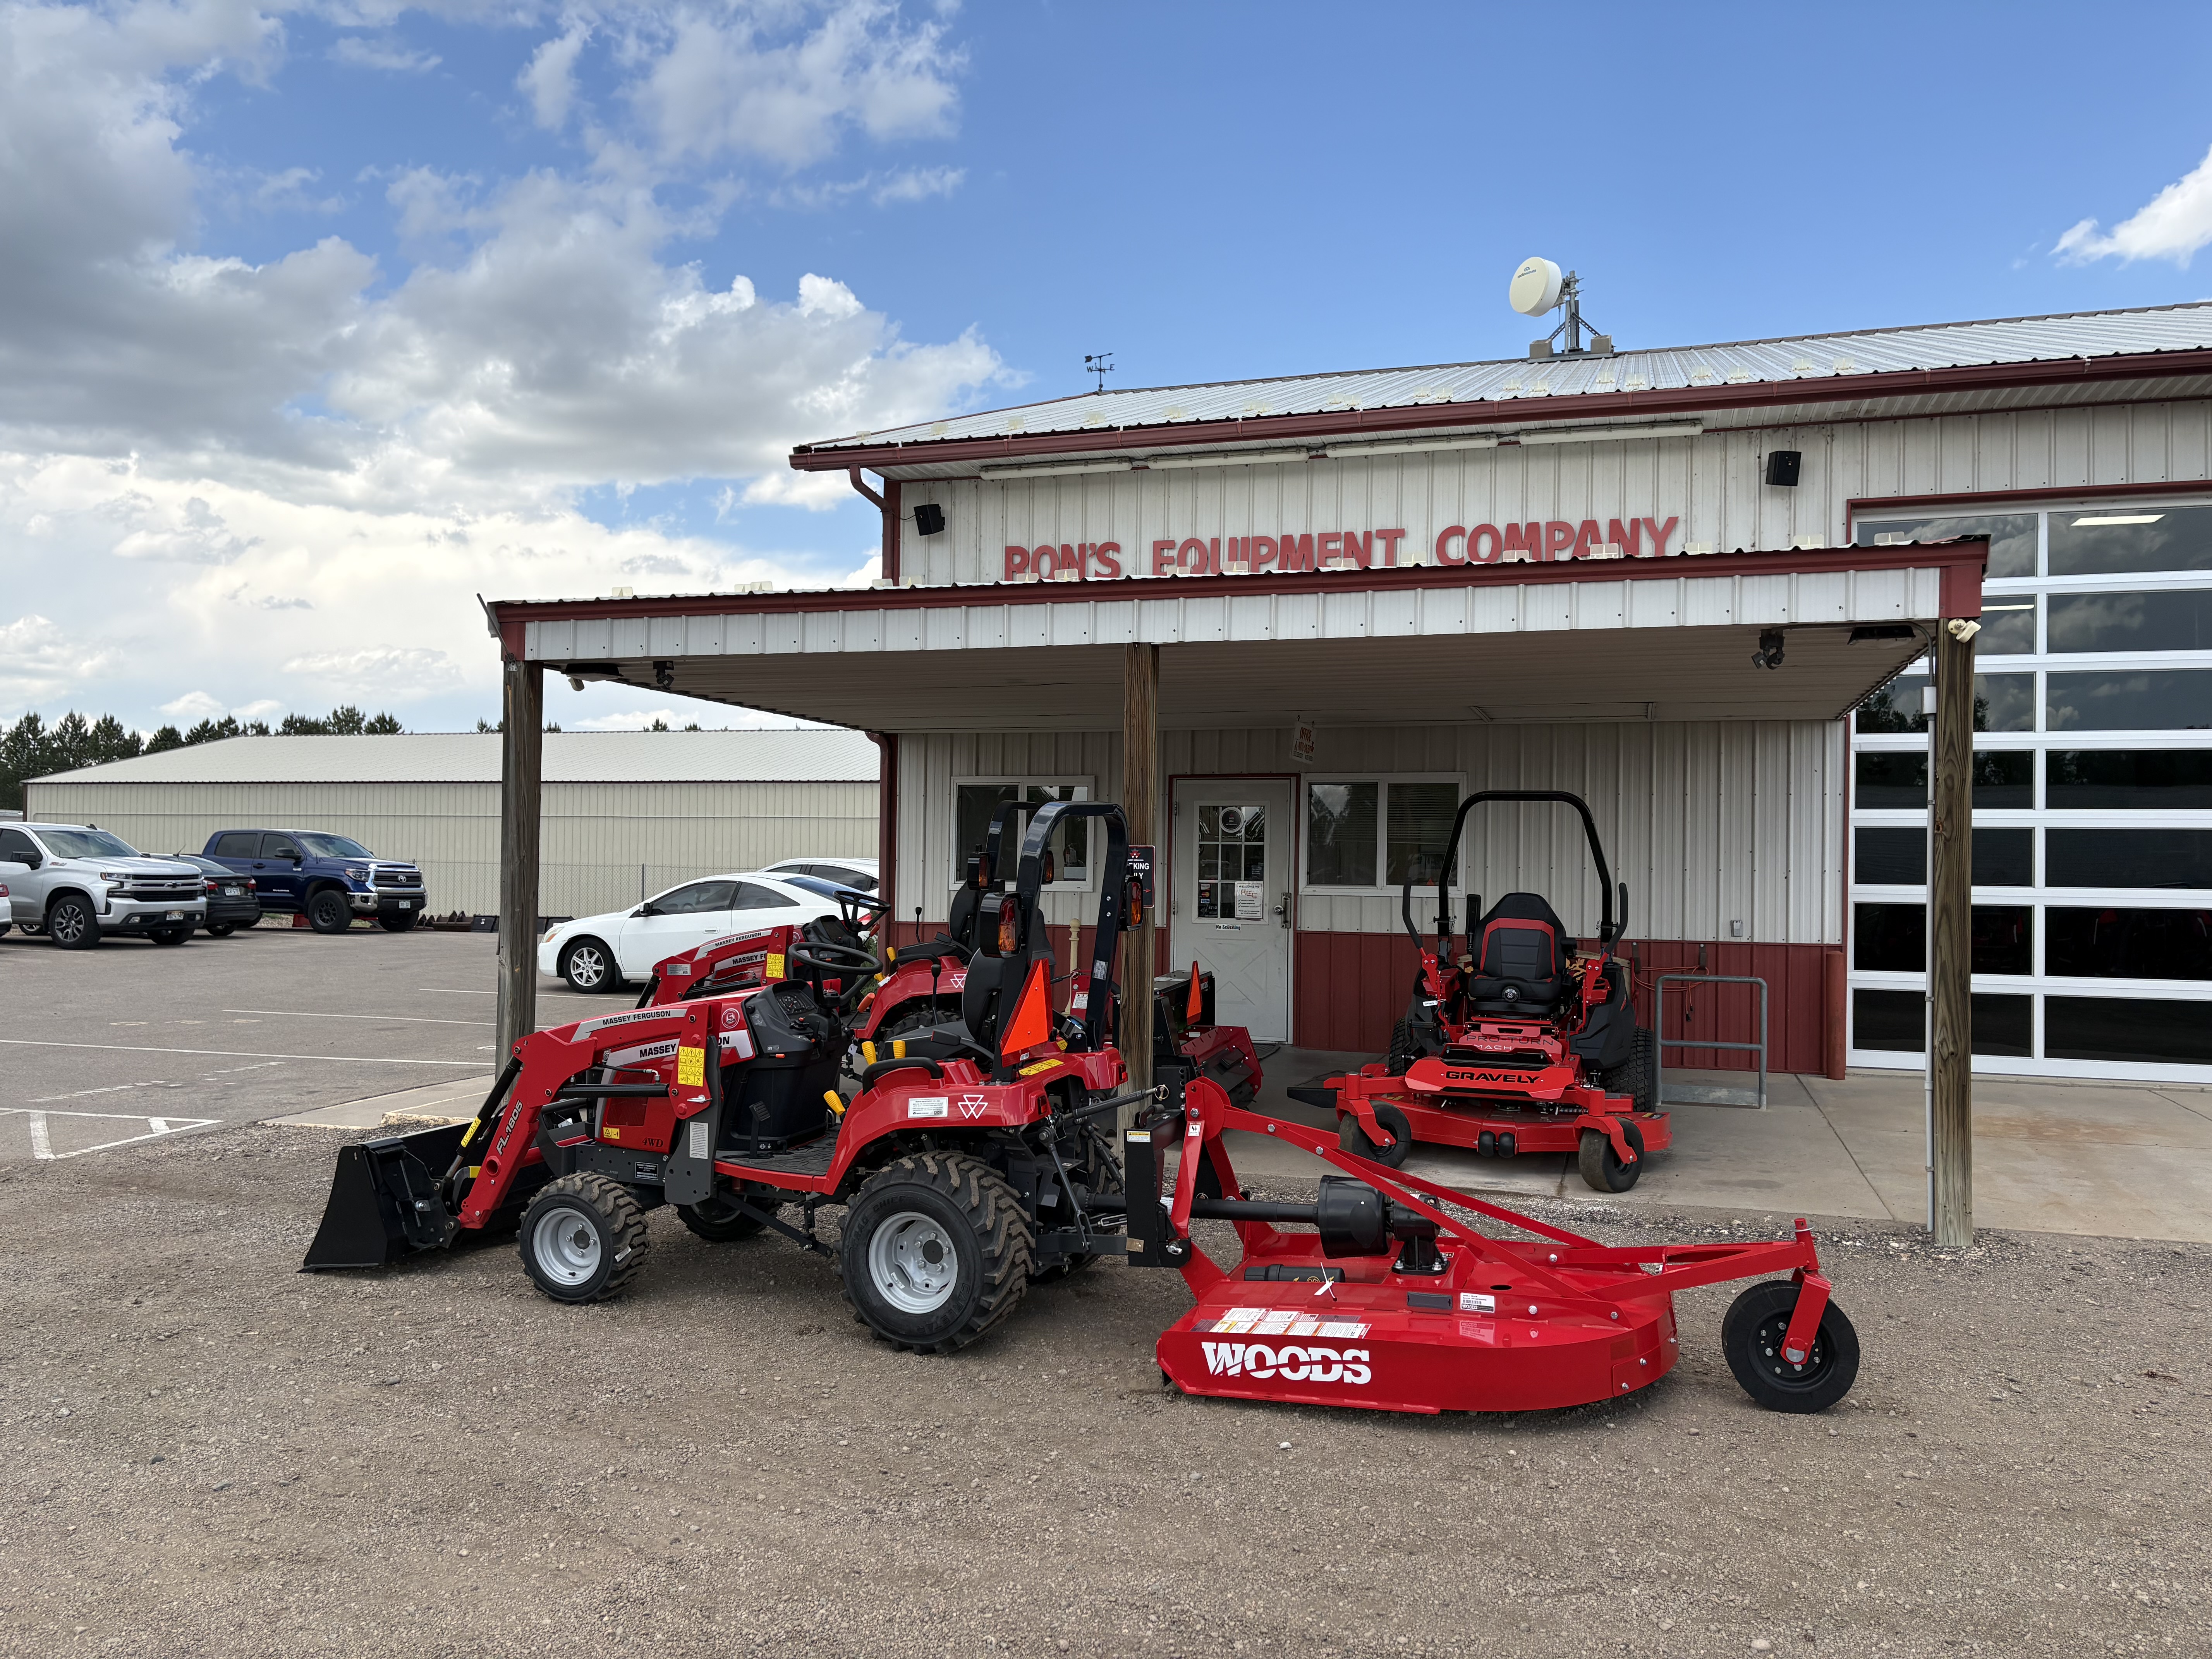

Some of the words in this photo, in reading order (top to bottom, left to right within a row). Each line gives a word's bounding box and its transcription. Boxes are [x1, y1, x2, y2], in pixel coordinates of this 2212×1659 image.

[1005, 541, 1121, 581] RON'S
[1152, 528, 1405, 575] EQUIPMENT
[1436, 516, 1679, 565] COMPANY
[715, 938, 734, 947] MASSEY
[736, 932, 762, 941] FERGUSON
[732, 955, 758, 965] MASSEY
[603, 1015, 631, 1025] MASSEY
[633, 1010, 671, 1020] FERGUSON
[1467, 1035, 1554, 1045] PRO-TURN
[639, 1043, 677, 1058] MASSEY
[1445, 1071, 1540, 1084] GRAVELY
[642, 1137, 663, 1147] 4WD
[1201, 1342, 1371, 1384] WOODS
